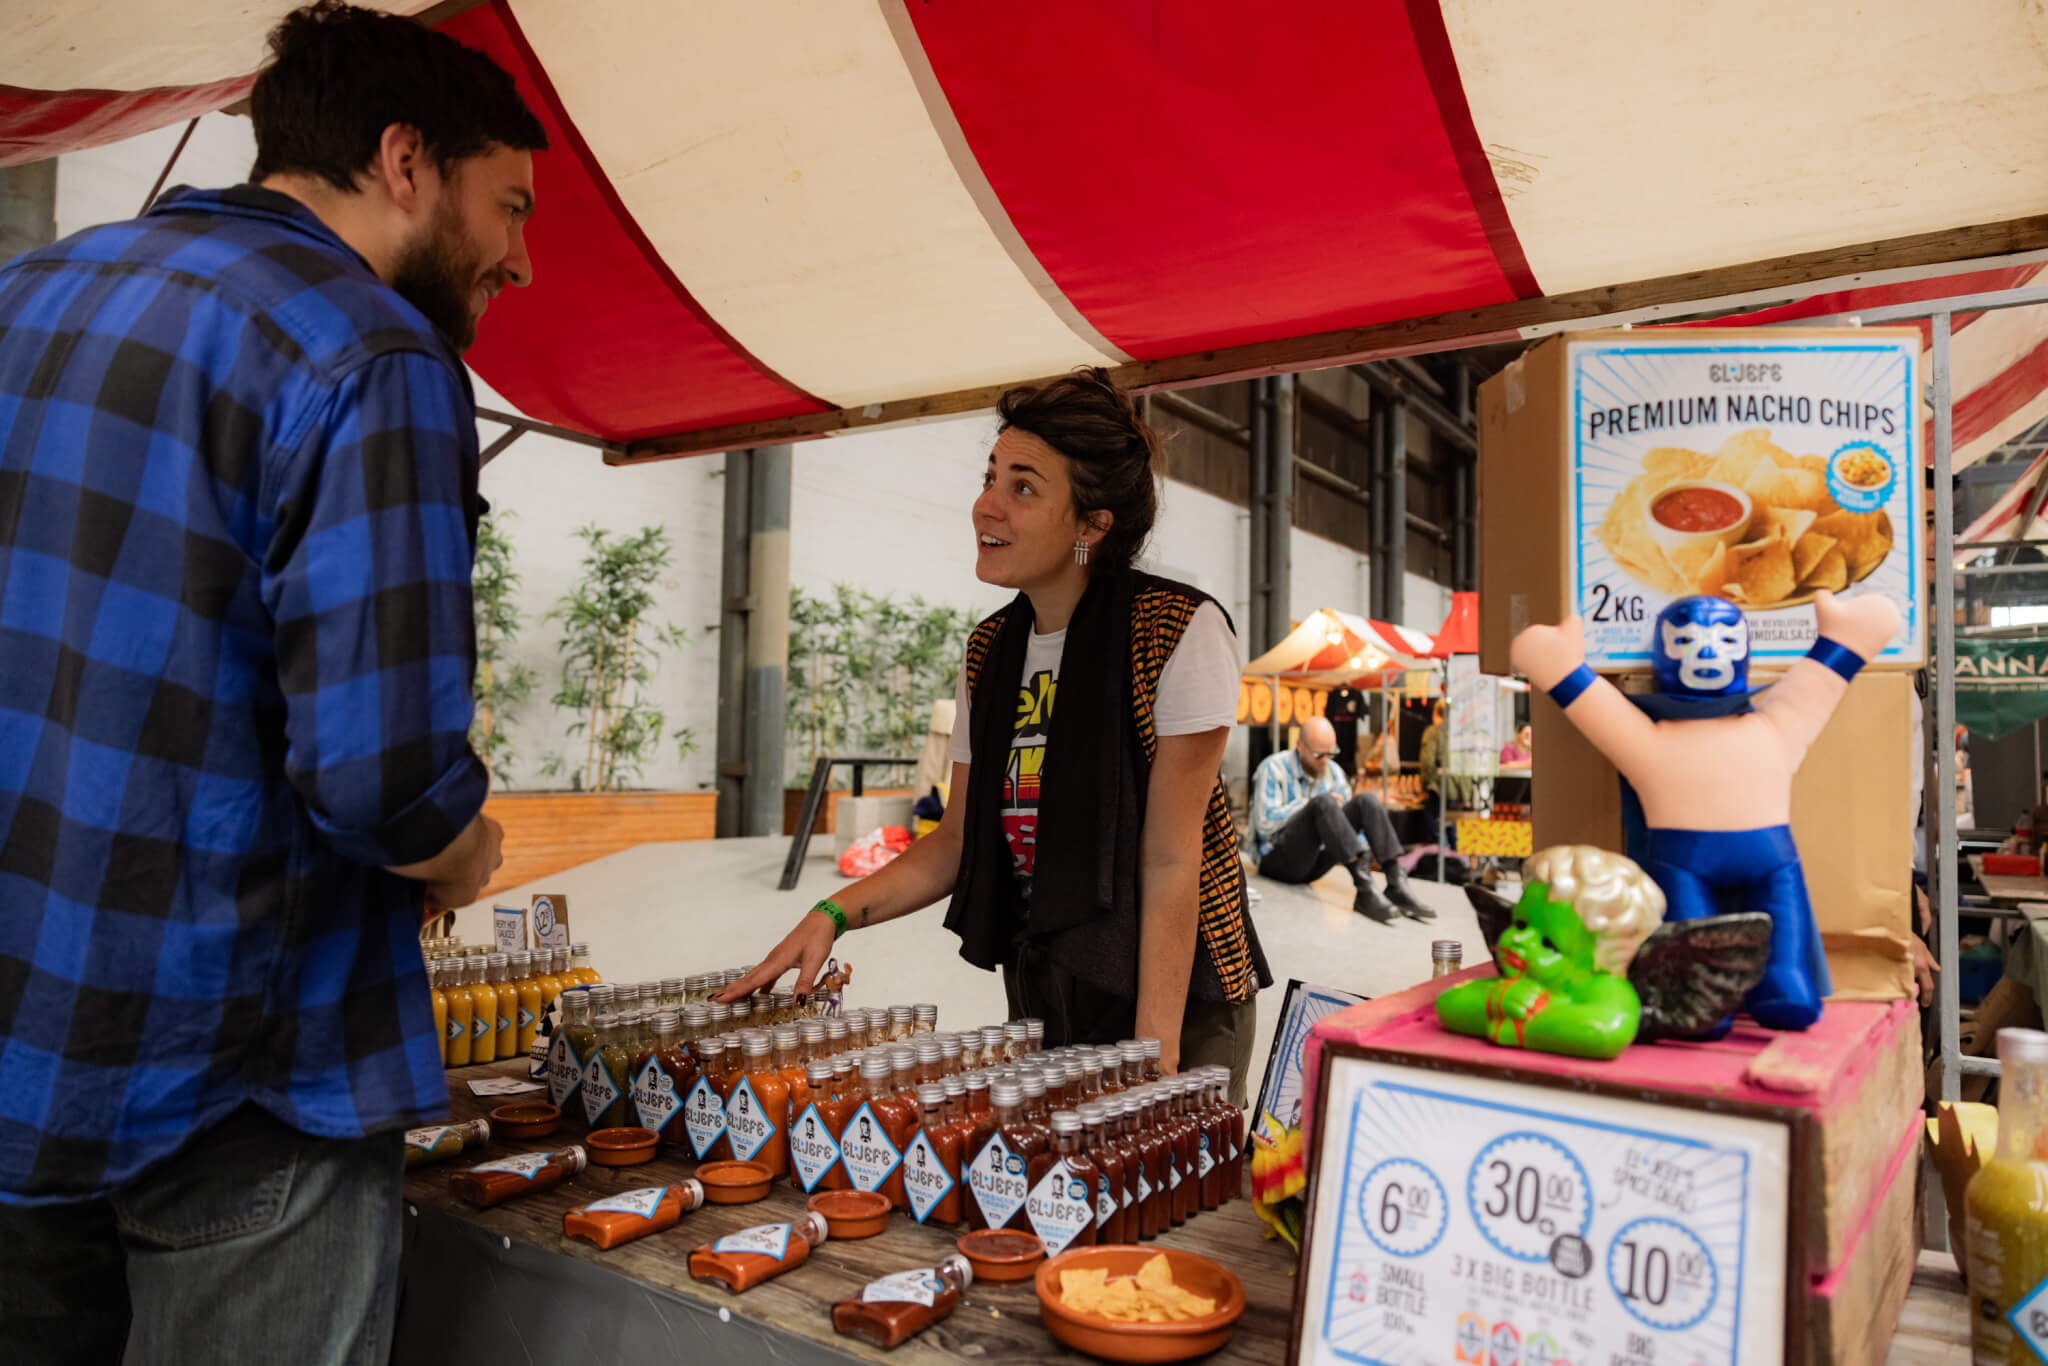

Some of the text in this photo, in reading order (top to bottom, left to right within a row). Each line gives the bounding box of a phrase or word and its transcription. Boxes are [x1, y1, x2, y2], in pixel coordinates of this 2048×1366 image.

[1590, 394, 1896, 440] PREMIUM NACHO CHIPS
[1380, 1182, 1404, 1234] 6
[1484, 1160, 1541, 1225] 30
[1381, 1262, 1425, 1293] SMALL
[1521, 1271, 1594, 1311] BOTTLE
[1621, 1241, 1670, 1307] 10
[1376, 1283, 1427, 1317] BOTTLE
